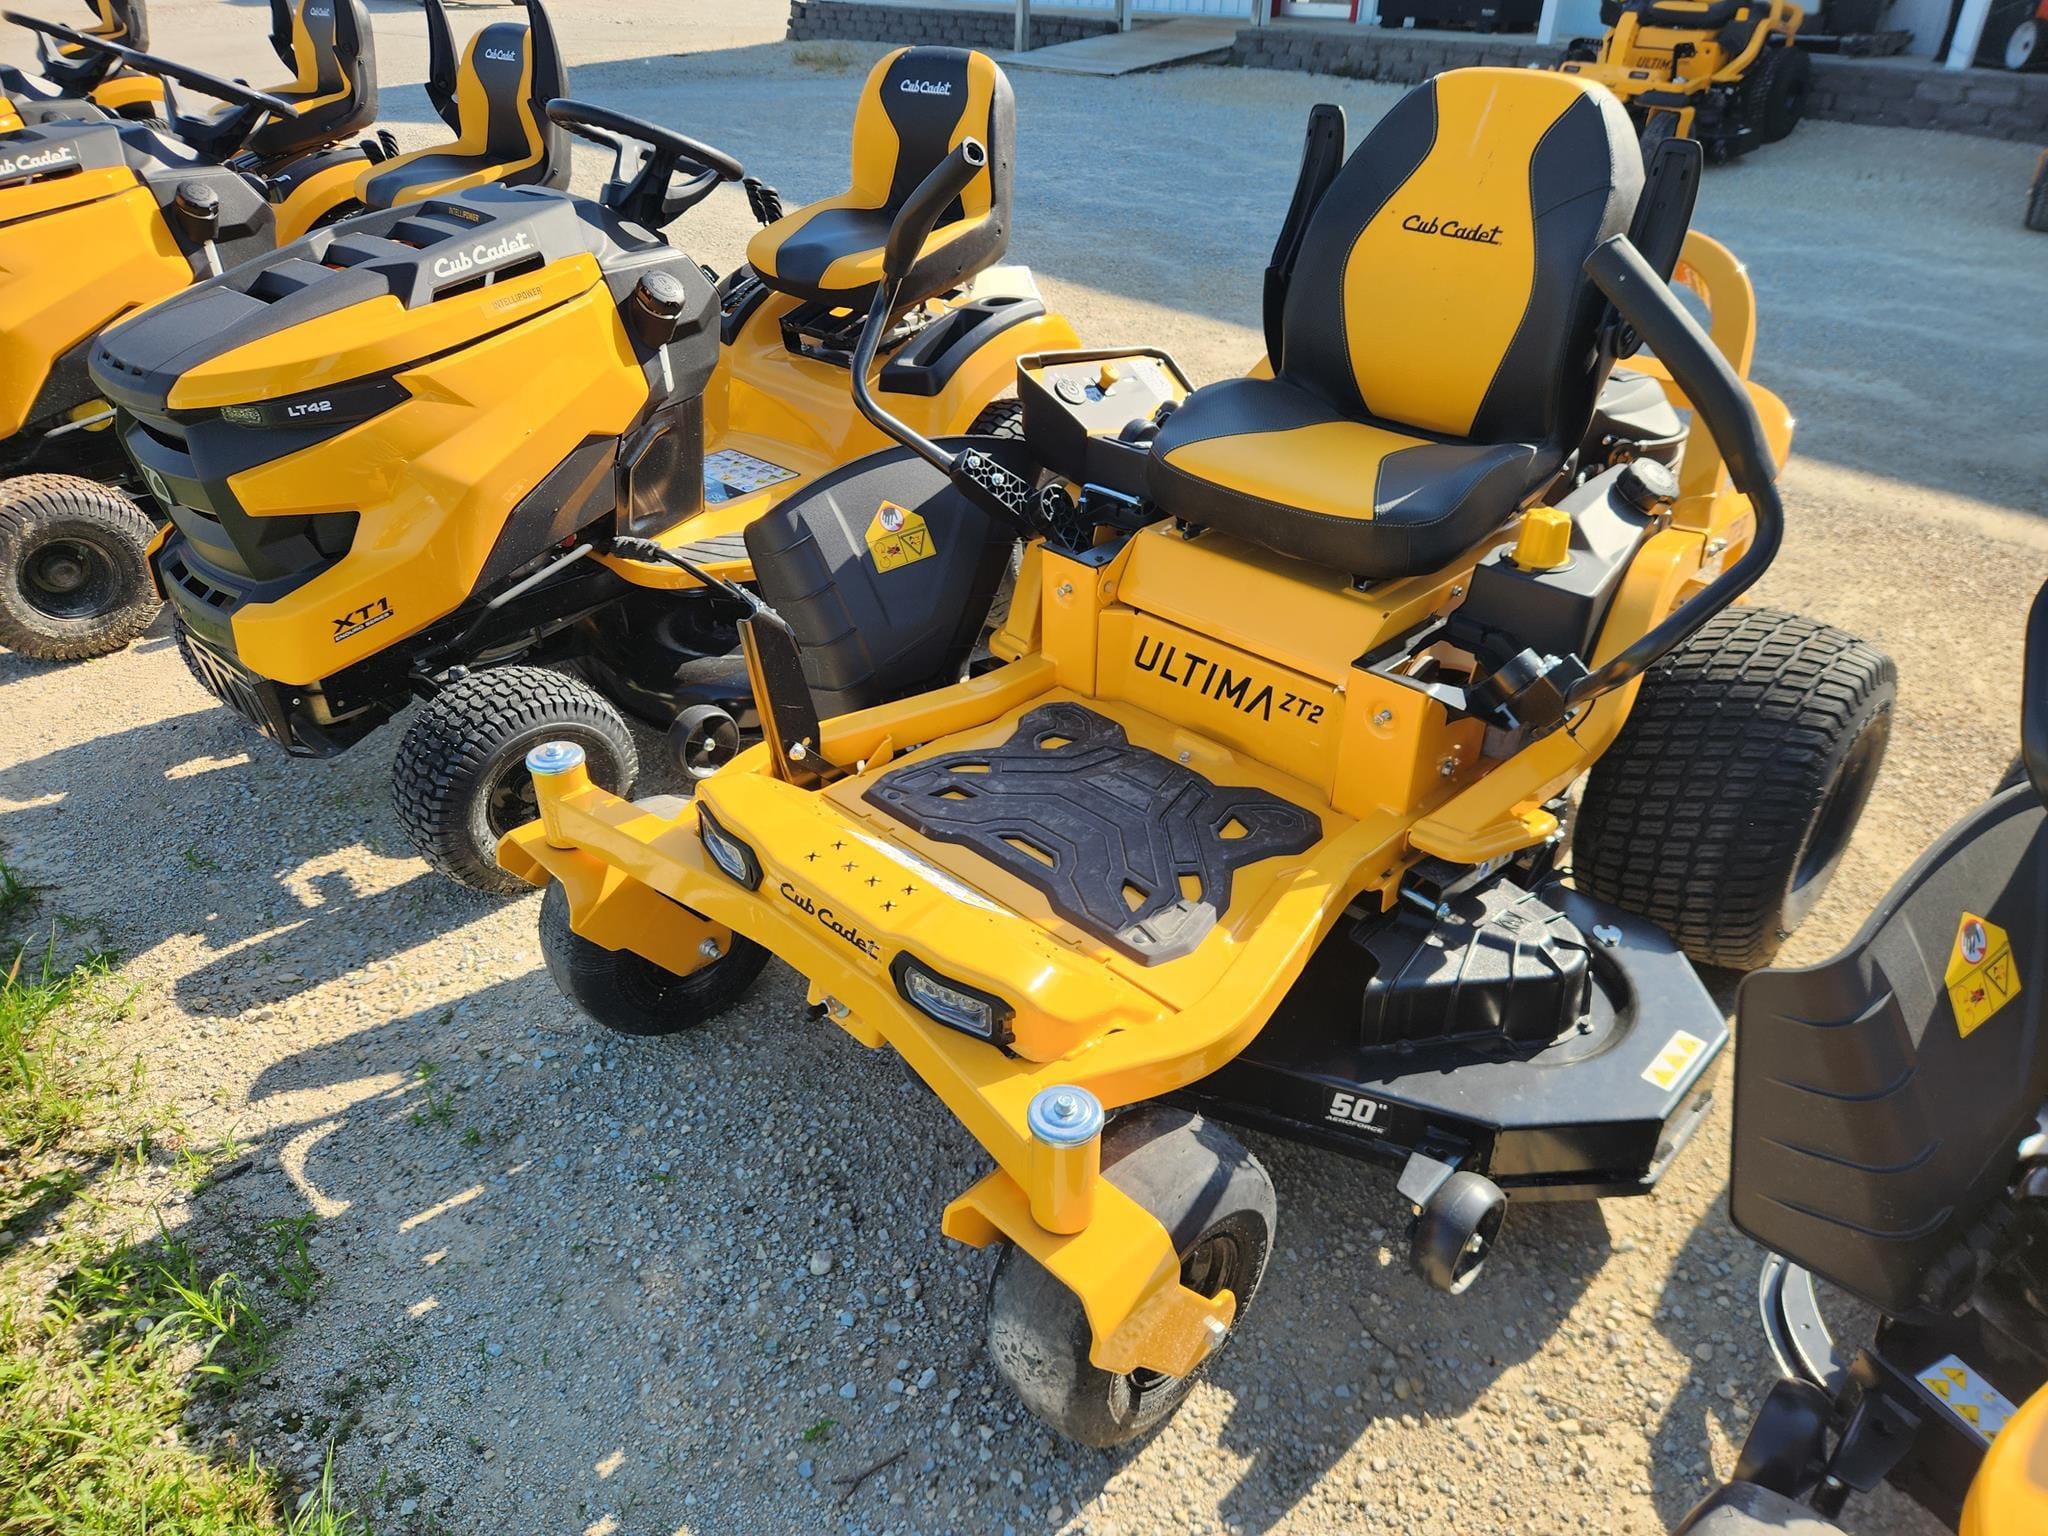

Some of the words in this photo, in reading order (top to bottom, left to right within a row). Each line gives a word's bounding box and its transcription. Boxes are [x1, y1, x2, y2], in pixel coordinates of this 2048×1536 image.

[1636, 56, 1675, 70] ULTIM
[900, 79, 920, 92] Cub
[920, 81, 952, 96] Cadet
[16, 146, 73, 170] Cadet
[1402, 214, 1438, 235] Cub
[1439, 220, 1504, 245] Cadet
[434, 257, 473, 278] Cub
[472, 232, 531, 265] Cadet
[492, 286, 544, 310] INTELLIPOWER
[287, 400, 333, 417] LT42
[331, 597, 388, 635] XT1
[335, 624, 365, 641] ENDURO
[1134, 635, 1273, 722] ULTIMA
[1278, 692, 1325, 724] ZT2
[780, 883, 815, 915] Cub
[817, 908, 880, 960] Cadet
[1329, 1092, 1388, 1124] 50"
[1324, 1115, 1385, 1135] AEROFORGE
